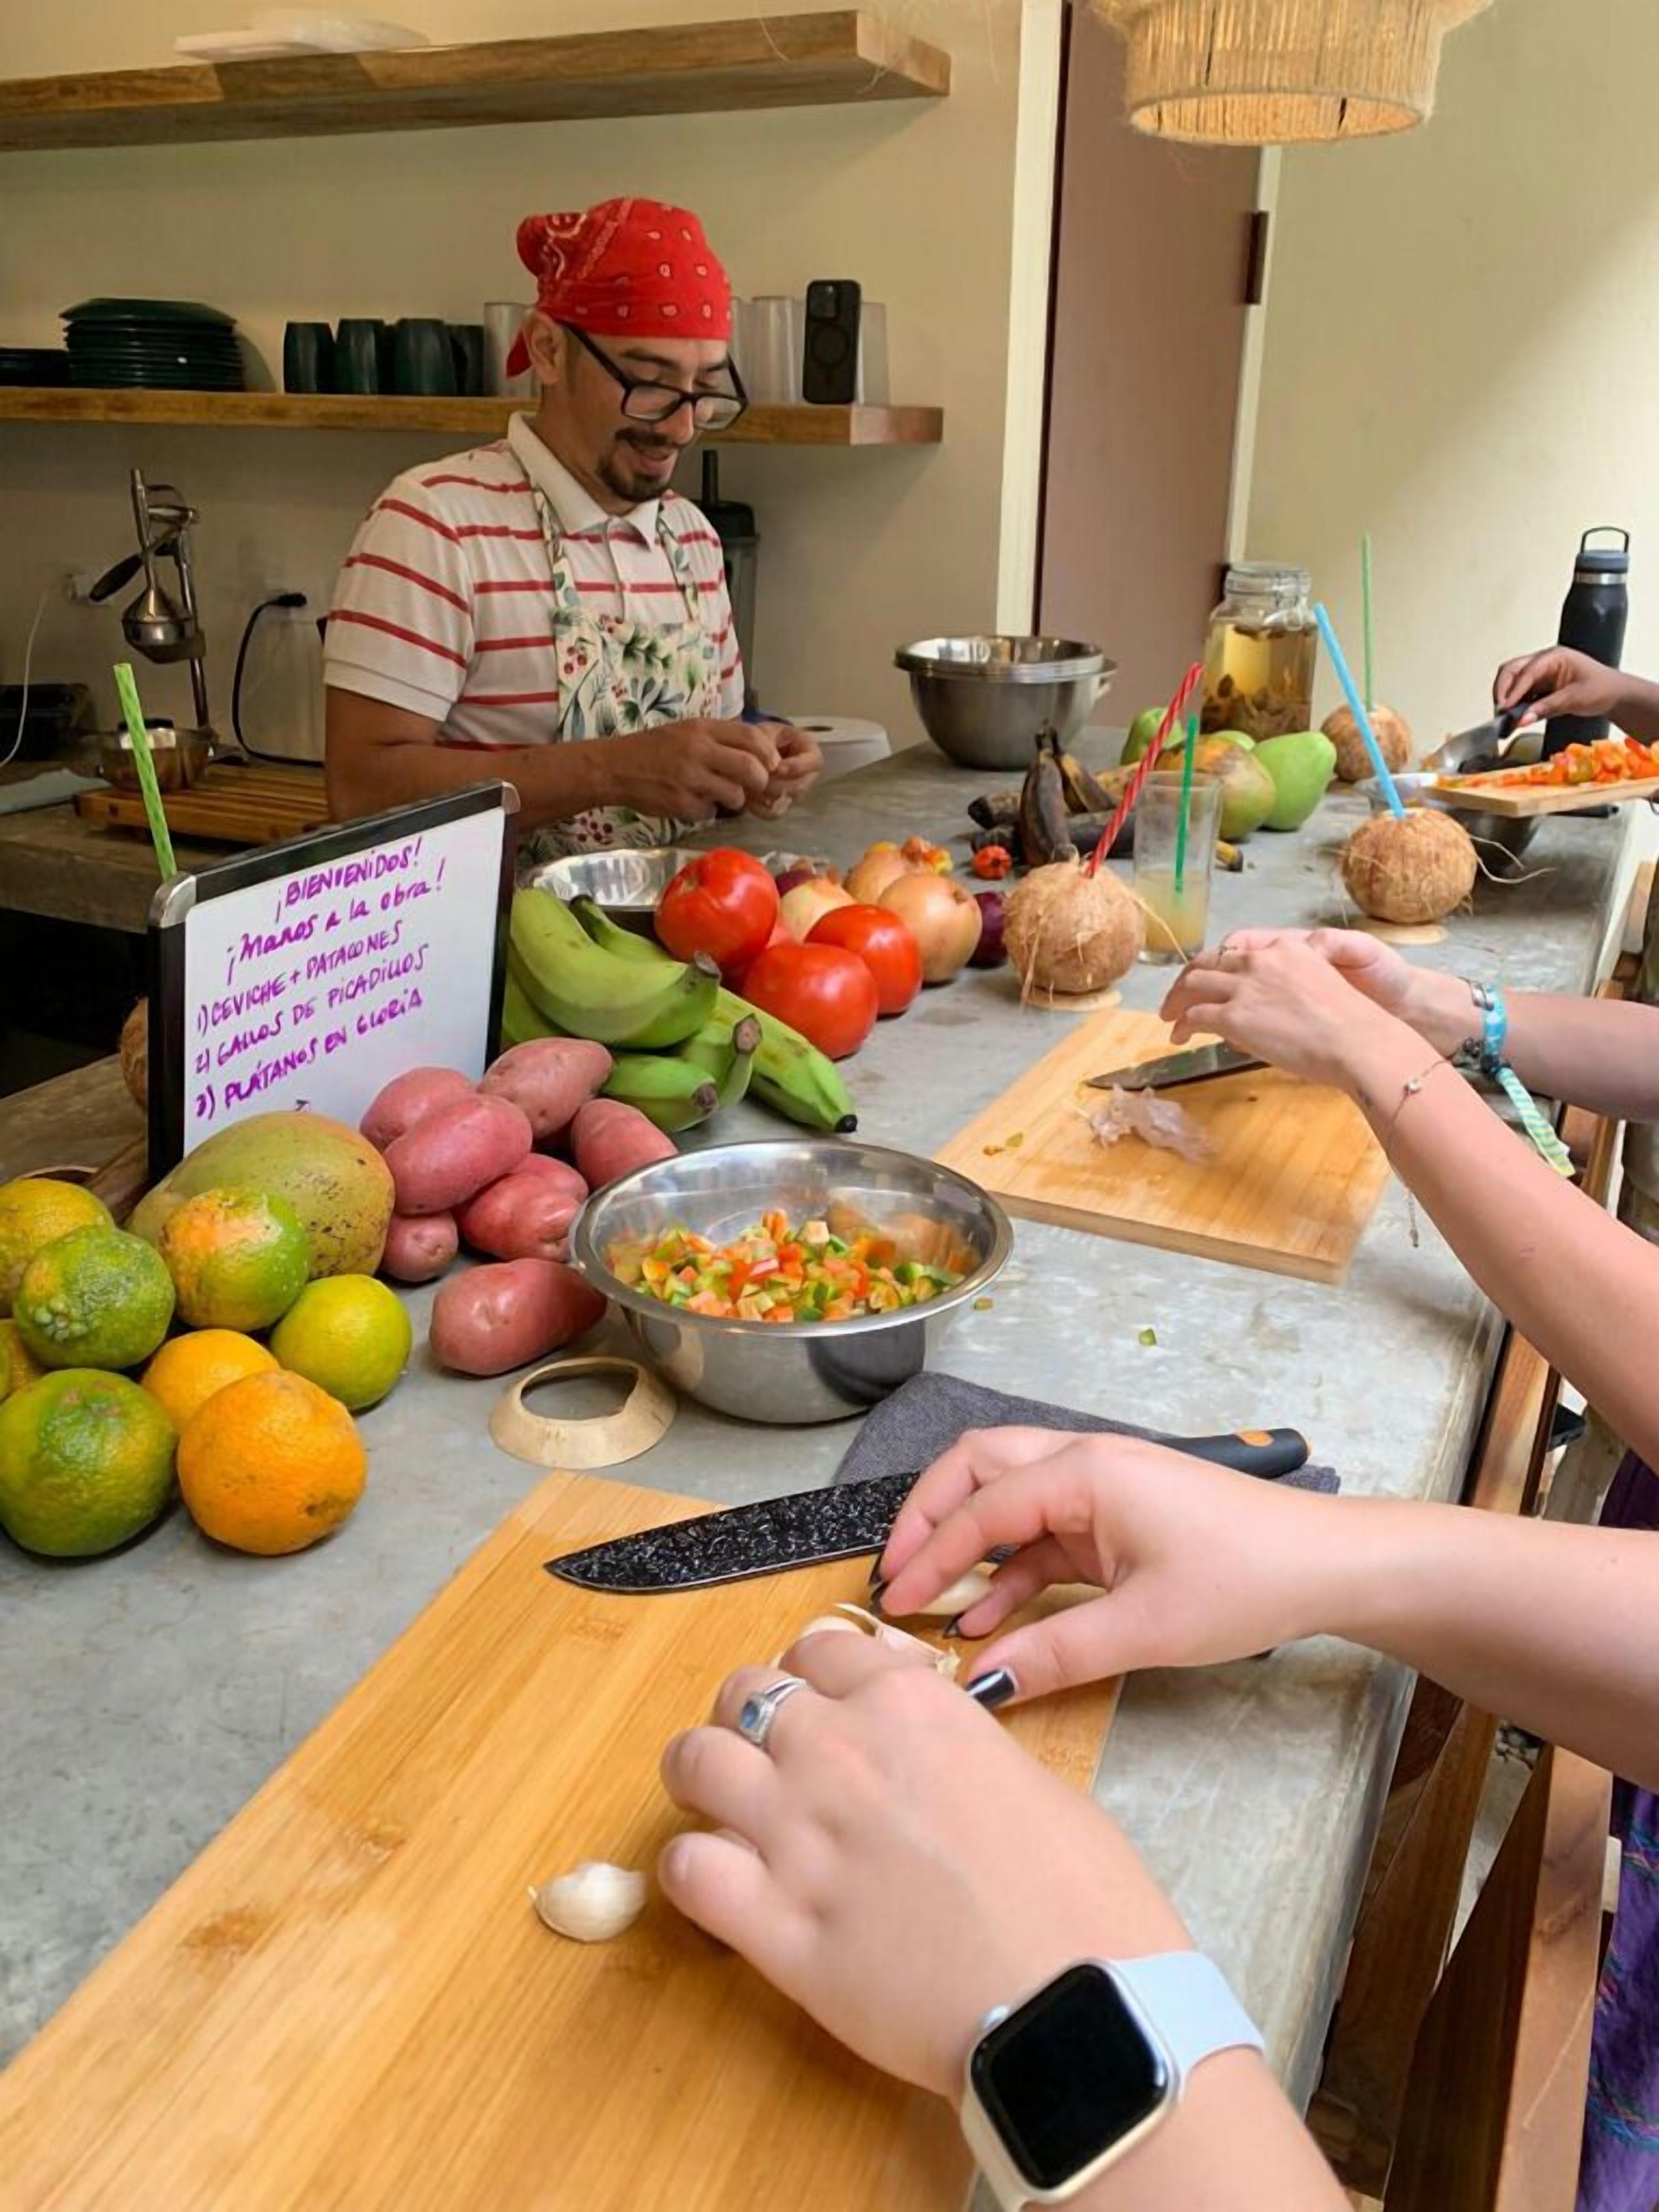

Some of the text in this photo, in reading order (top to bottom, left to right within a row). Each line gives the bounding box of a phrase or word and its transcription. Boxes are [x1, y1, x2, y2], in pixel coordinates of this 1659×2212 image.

[325, 911, 341, 933] a
[350, 898, 370, 920] la
[306, 920, 403, 980] PATACONES
[218, 1010, 284, 1065] GALLOS
[292, 996, 317, 1026] DE
[325, 1026, 347, 1054] EN
